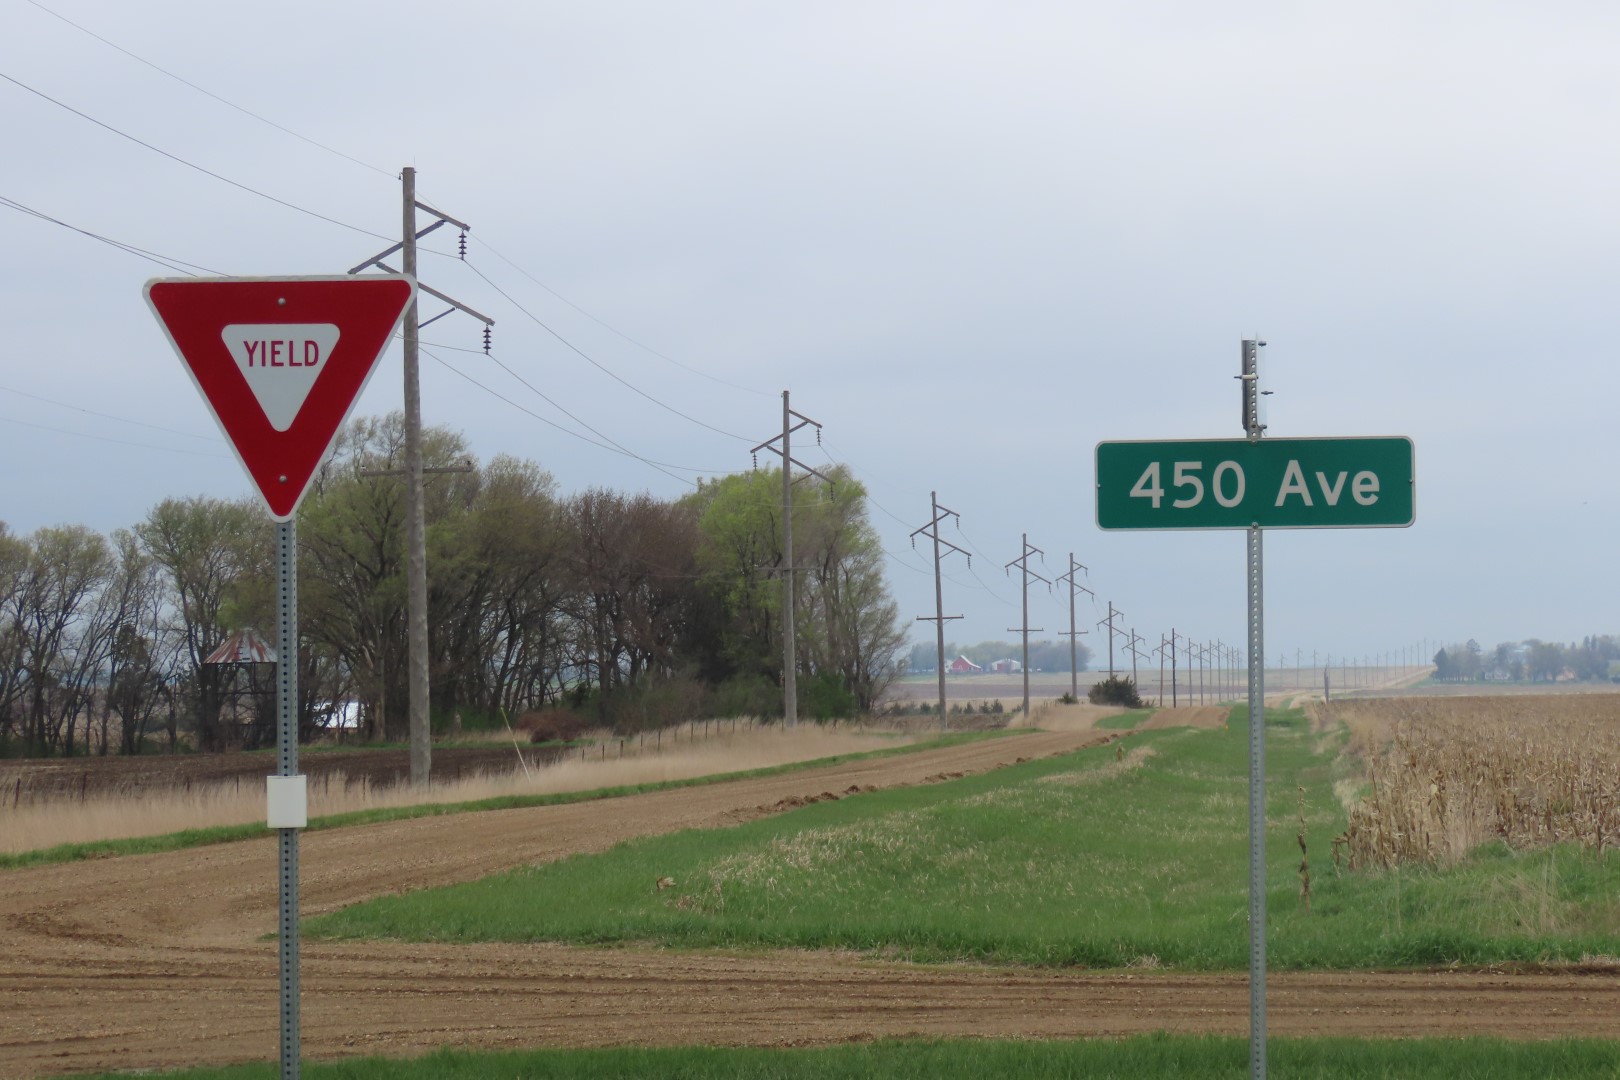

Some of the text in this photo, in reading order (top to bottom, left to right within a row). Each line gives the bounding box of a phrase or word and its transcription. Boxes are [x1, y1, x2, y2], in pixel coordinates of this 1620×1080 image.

[243, 340, 320, 367] YIELD
[1129, 459, 1381, 509] 450 Ave
